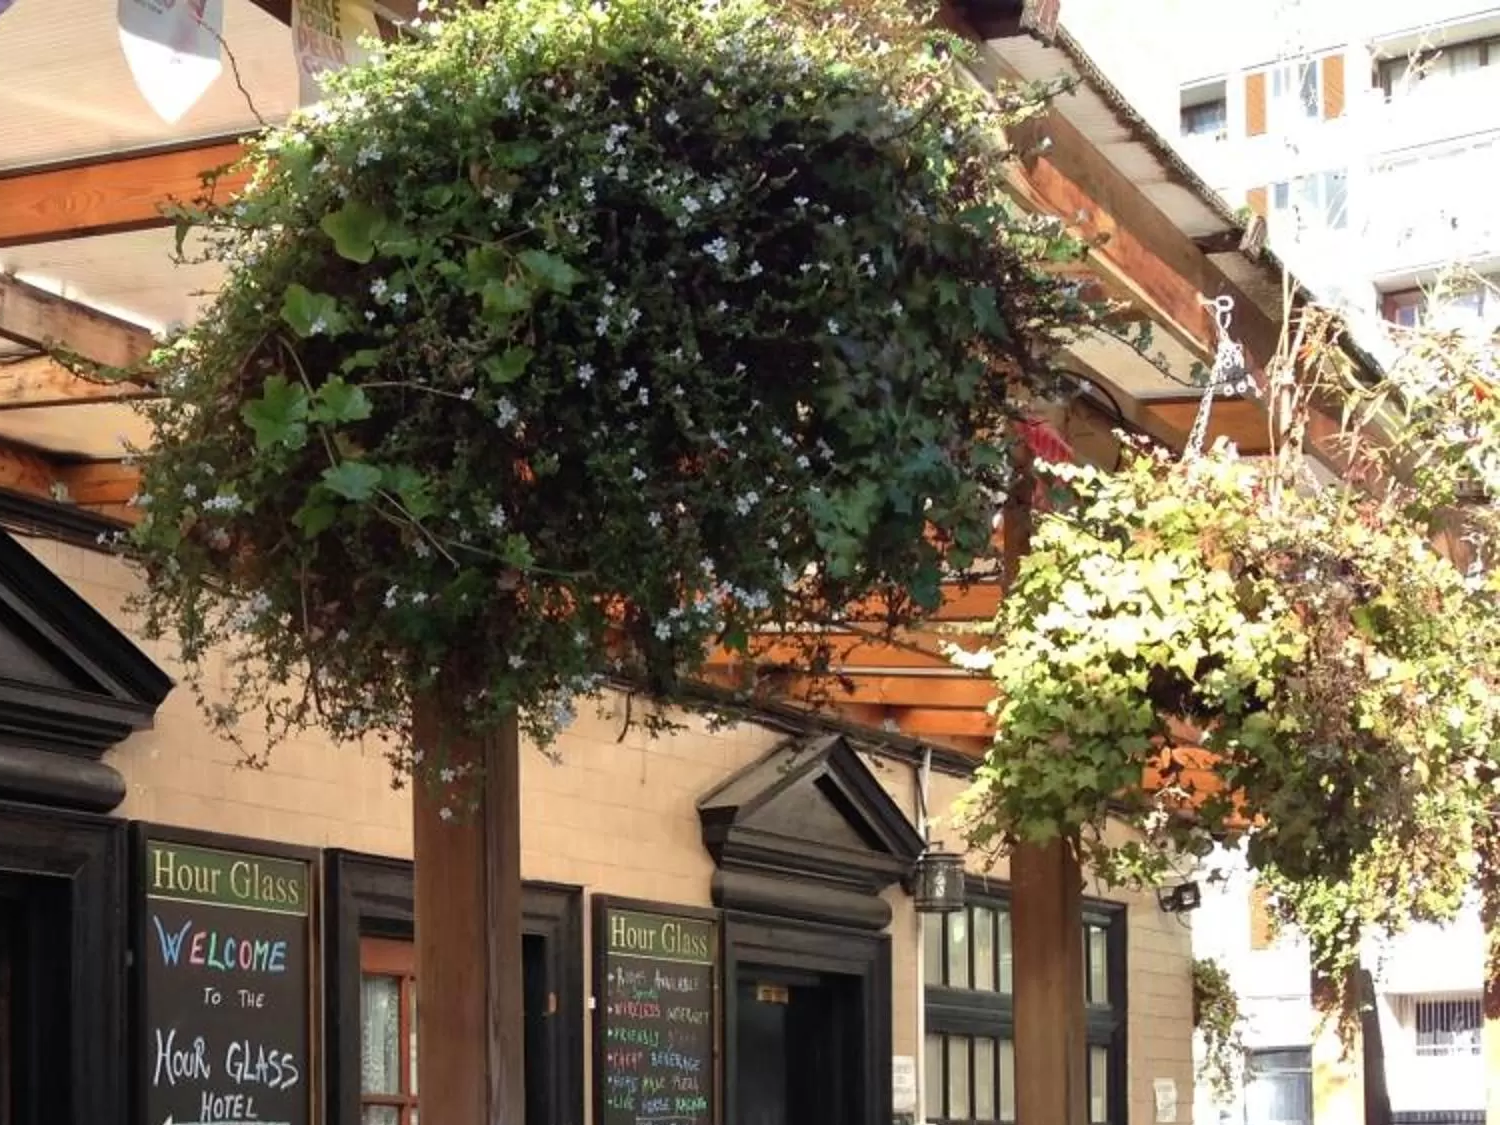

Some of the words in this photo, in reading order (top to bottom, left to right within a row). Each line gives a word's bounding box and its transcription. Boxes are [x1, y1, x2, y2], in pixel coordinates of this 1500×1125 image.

[152, 849, 221, 895] Hour
[230, 860, 300, 905] Glass
[153, 914, 288, 973] WELCOME
[610, 916, 656, 949] Hour
[661, 922, 709, 958] Glass
[238, 988, 266, 1009] THE
[225, 1039, 299, 1090] GLASS
[201, 1091, 258, 1125] HOTEL
